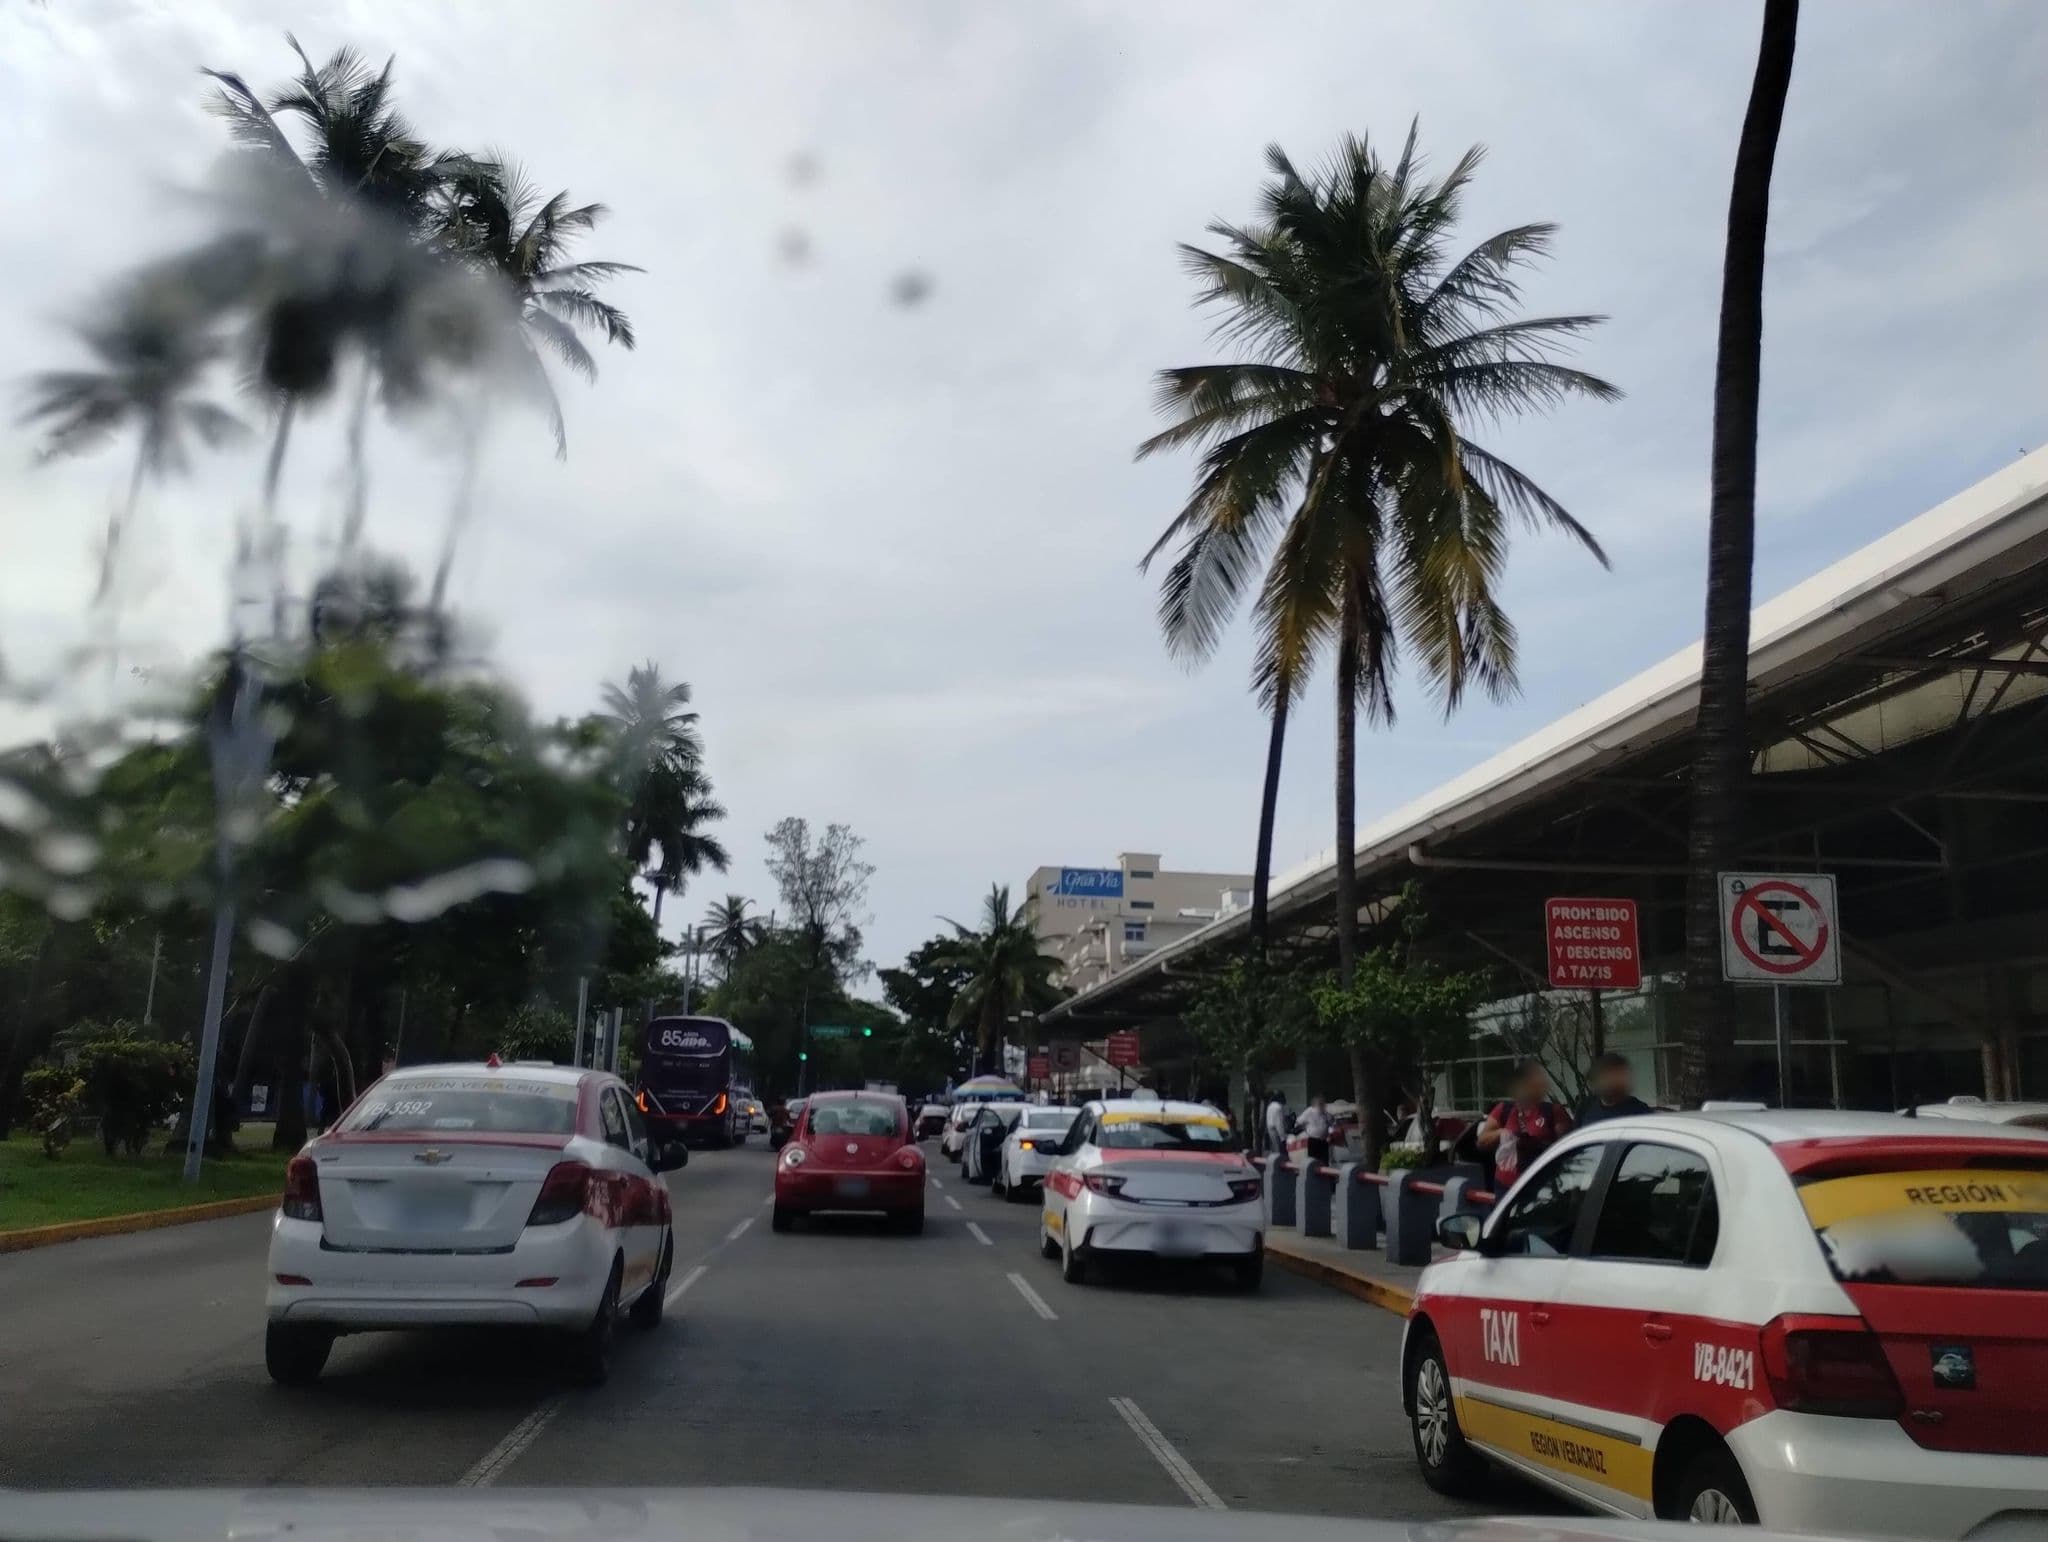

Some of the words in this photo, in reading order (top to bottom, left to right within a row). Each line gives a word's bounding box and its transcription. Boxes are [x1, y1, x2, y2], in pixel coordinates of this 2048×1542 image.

[1554, 926, 1621, 940] ASCENSO
[1555, 945, 1563, 959] Y
[1567, 946, 1632, 960] DESCENSO
[1556, 965, 1566, 979] A
[1569, 965, 1612, 980] TAXIS
[661, 1029, 682, 1046] 85
[1905, 1178, 2008, 1205] REGIÓN
[1480, 1308, 1520, 1367] TAXI
[1694, 1341, 1754, 1391] VB-8421
[1559, 1439, 1607, 1475] VERACRUZ
